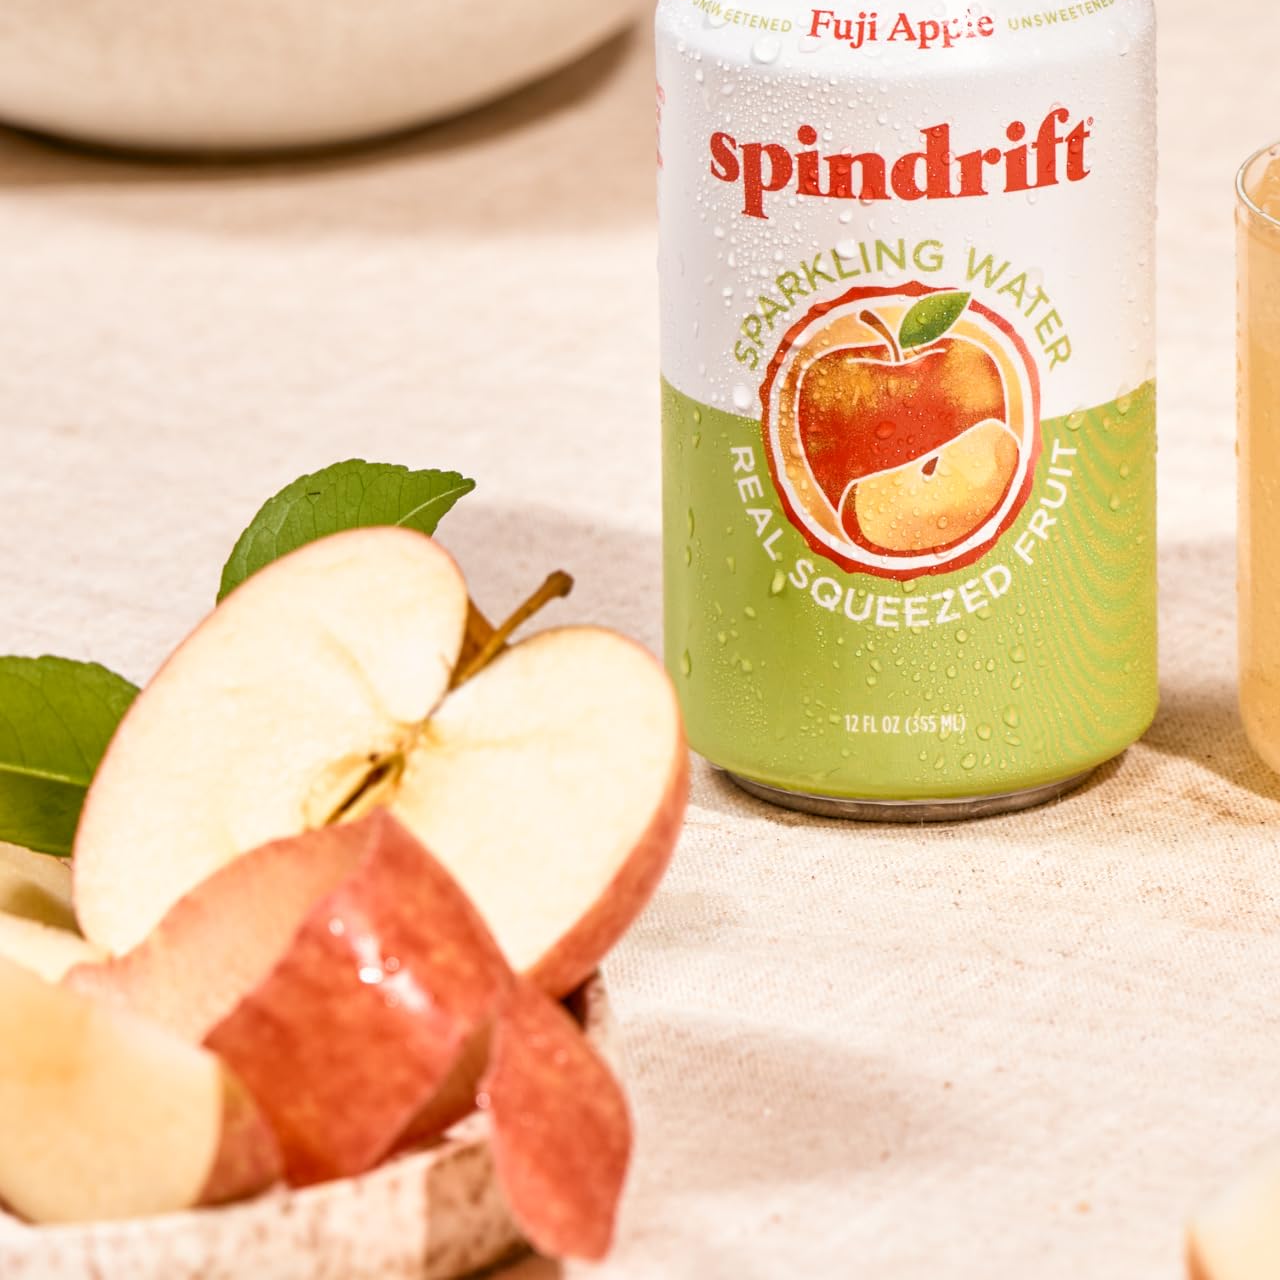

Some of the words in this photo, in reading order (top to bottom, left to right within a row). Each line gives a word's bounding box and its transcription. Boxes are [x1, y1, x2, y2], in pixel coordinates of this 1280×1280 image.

[806, 9, 878, 49] Fuji
[709, 107, 1093, 220] spindrift
[734, 237, 945, 371] SPARKLING
[965, 247, 1073, 373] WATER
[730, 445, 793, 562] REAL
[788, 558, 1014, 629] SQUEEZED
[1013, 439, 1078, 566] FRUIT
[844, 713, 860, 733] 12
[863, 714, 879, 733] FL
[881, 714, 901, 734] OZ
[905, 713, 938, 736] (355
[940, 713, 967, 735] ML)
